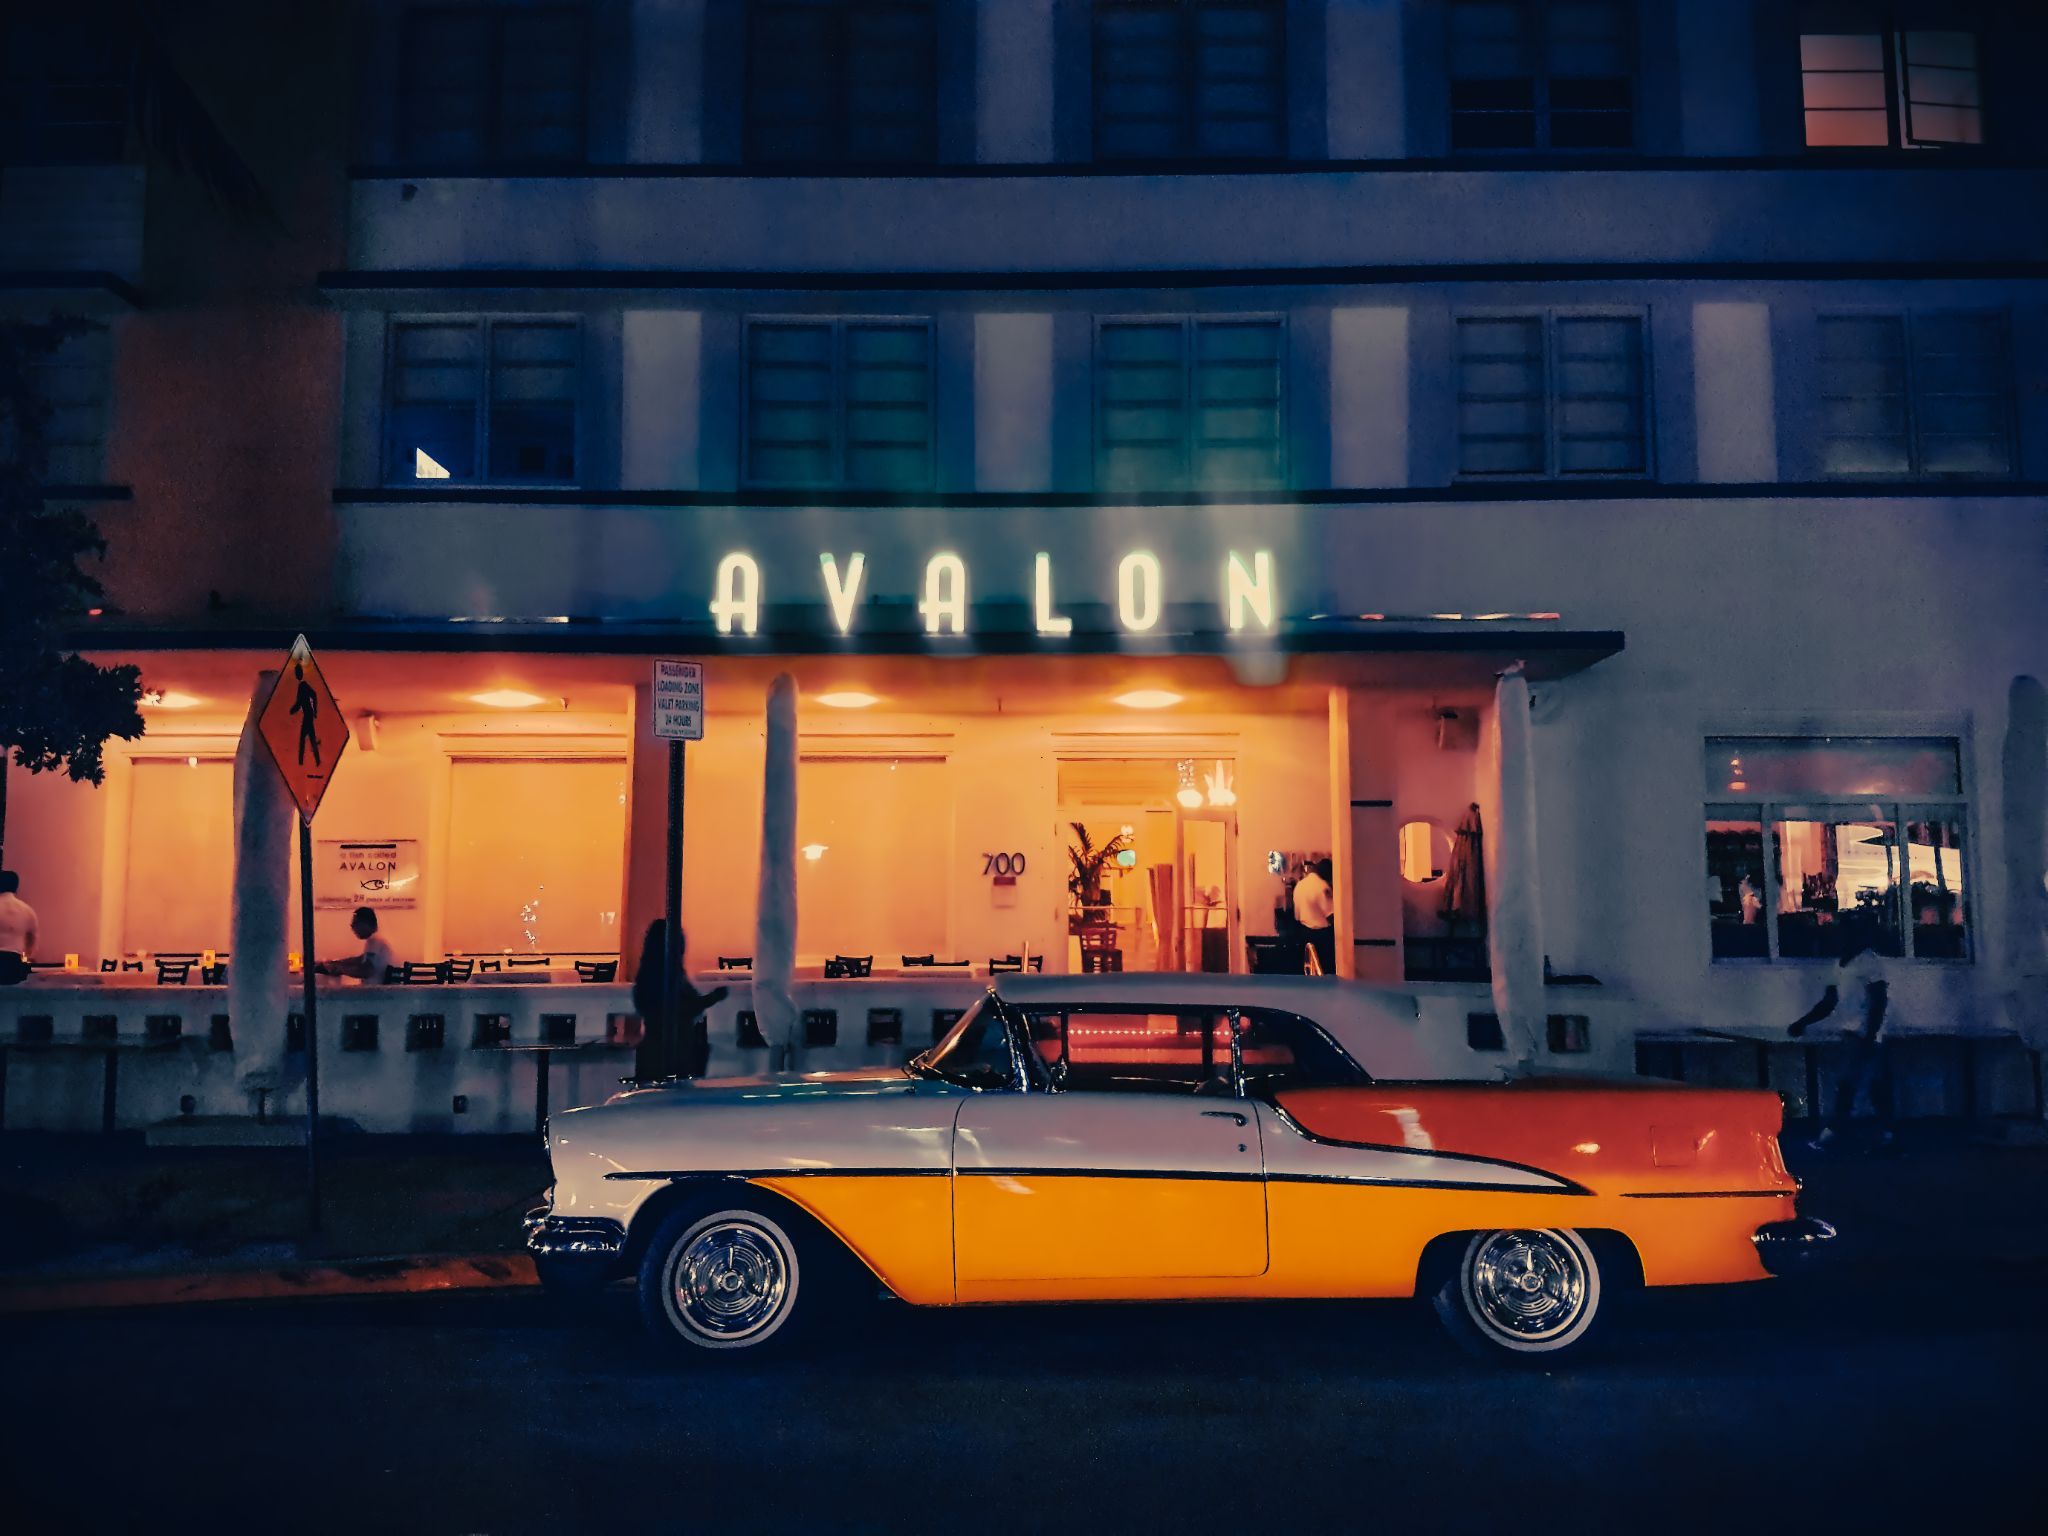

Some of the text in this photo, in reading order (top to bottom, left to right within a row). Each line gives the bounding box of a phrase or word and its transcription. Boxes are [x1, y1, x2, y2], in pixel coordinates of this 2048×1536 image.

[709, 551, 1272, 634] AVALON
[657, 681, 699, 694] LOADING ZONE
[658, 698, 699, 712] VALET PARKING
[673, 714, 691, 727] HOURS
[340, 862, 396, 870] AVALON
[982, 852, 1025, 876] 700
